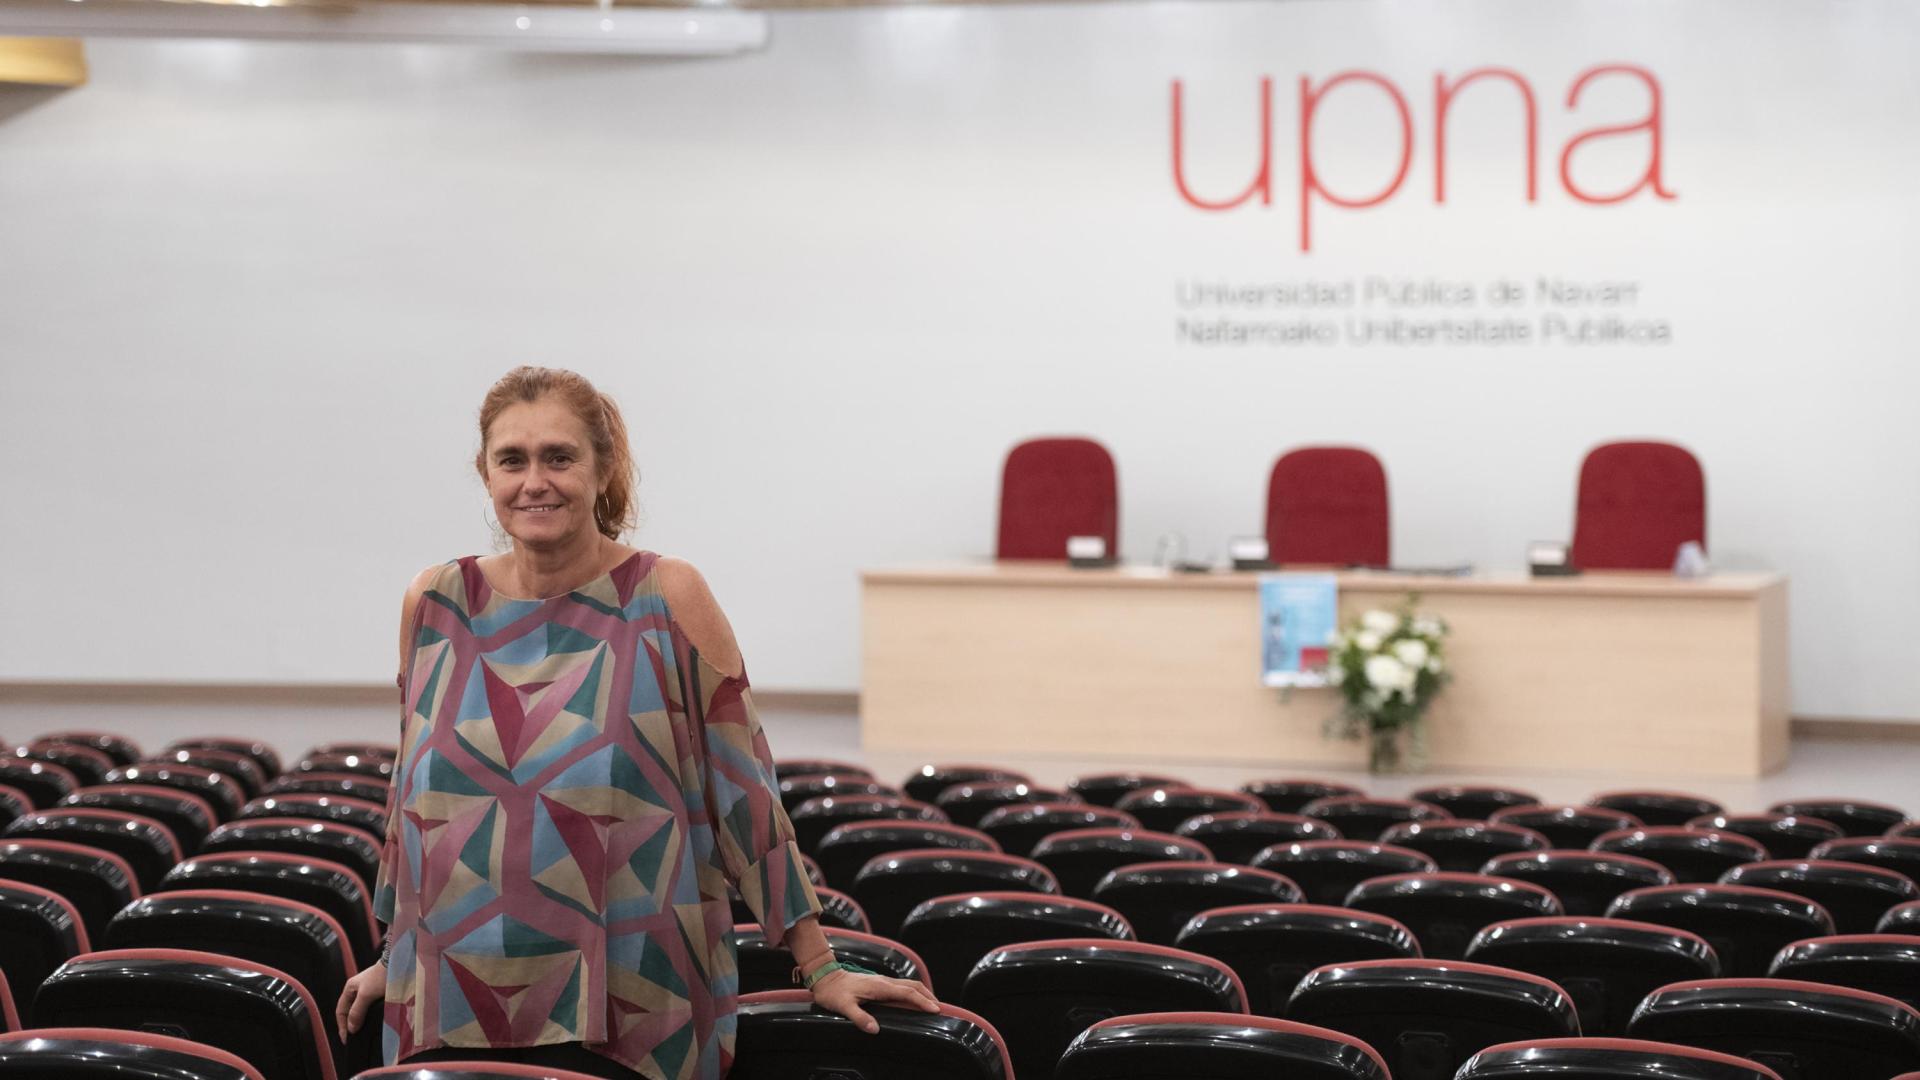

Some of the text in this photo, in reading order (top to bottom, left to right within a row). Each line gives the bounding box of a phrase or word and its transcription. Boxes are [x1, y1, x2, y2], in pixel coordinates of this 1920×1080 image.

[1169, 63, 1679, 253] upna
[1176, 279, 1354, 307] Universidad
[1487, 280, 1526, 307] de
[1176, 317, 1672, 346] Nafarroako Unibertsitate Publikoa
